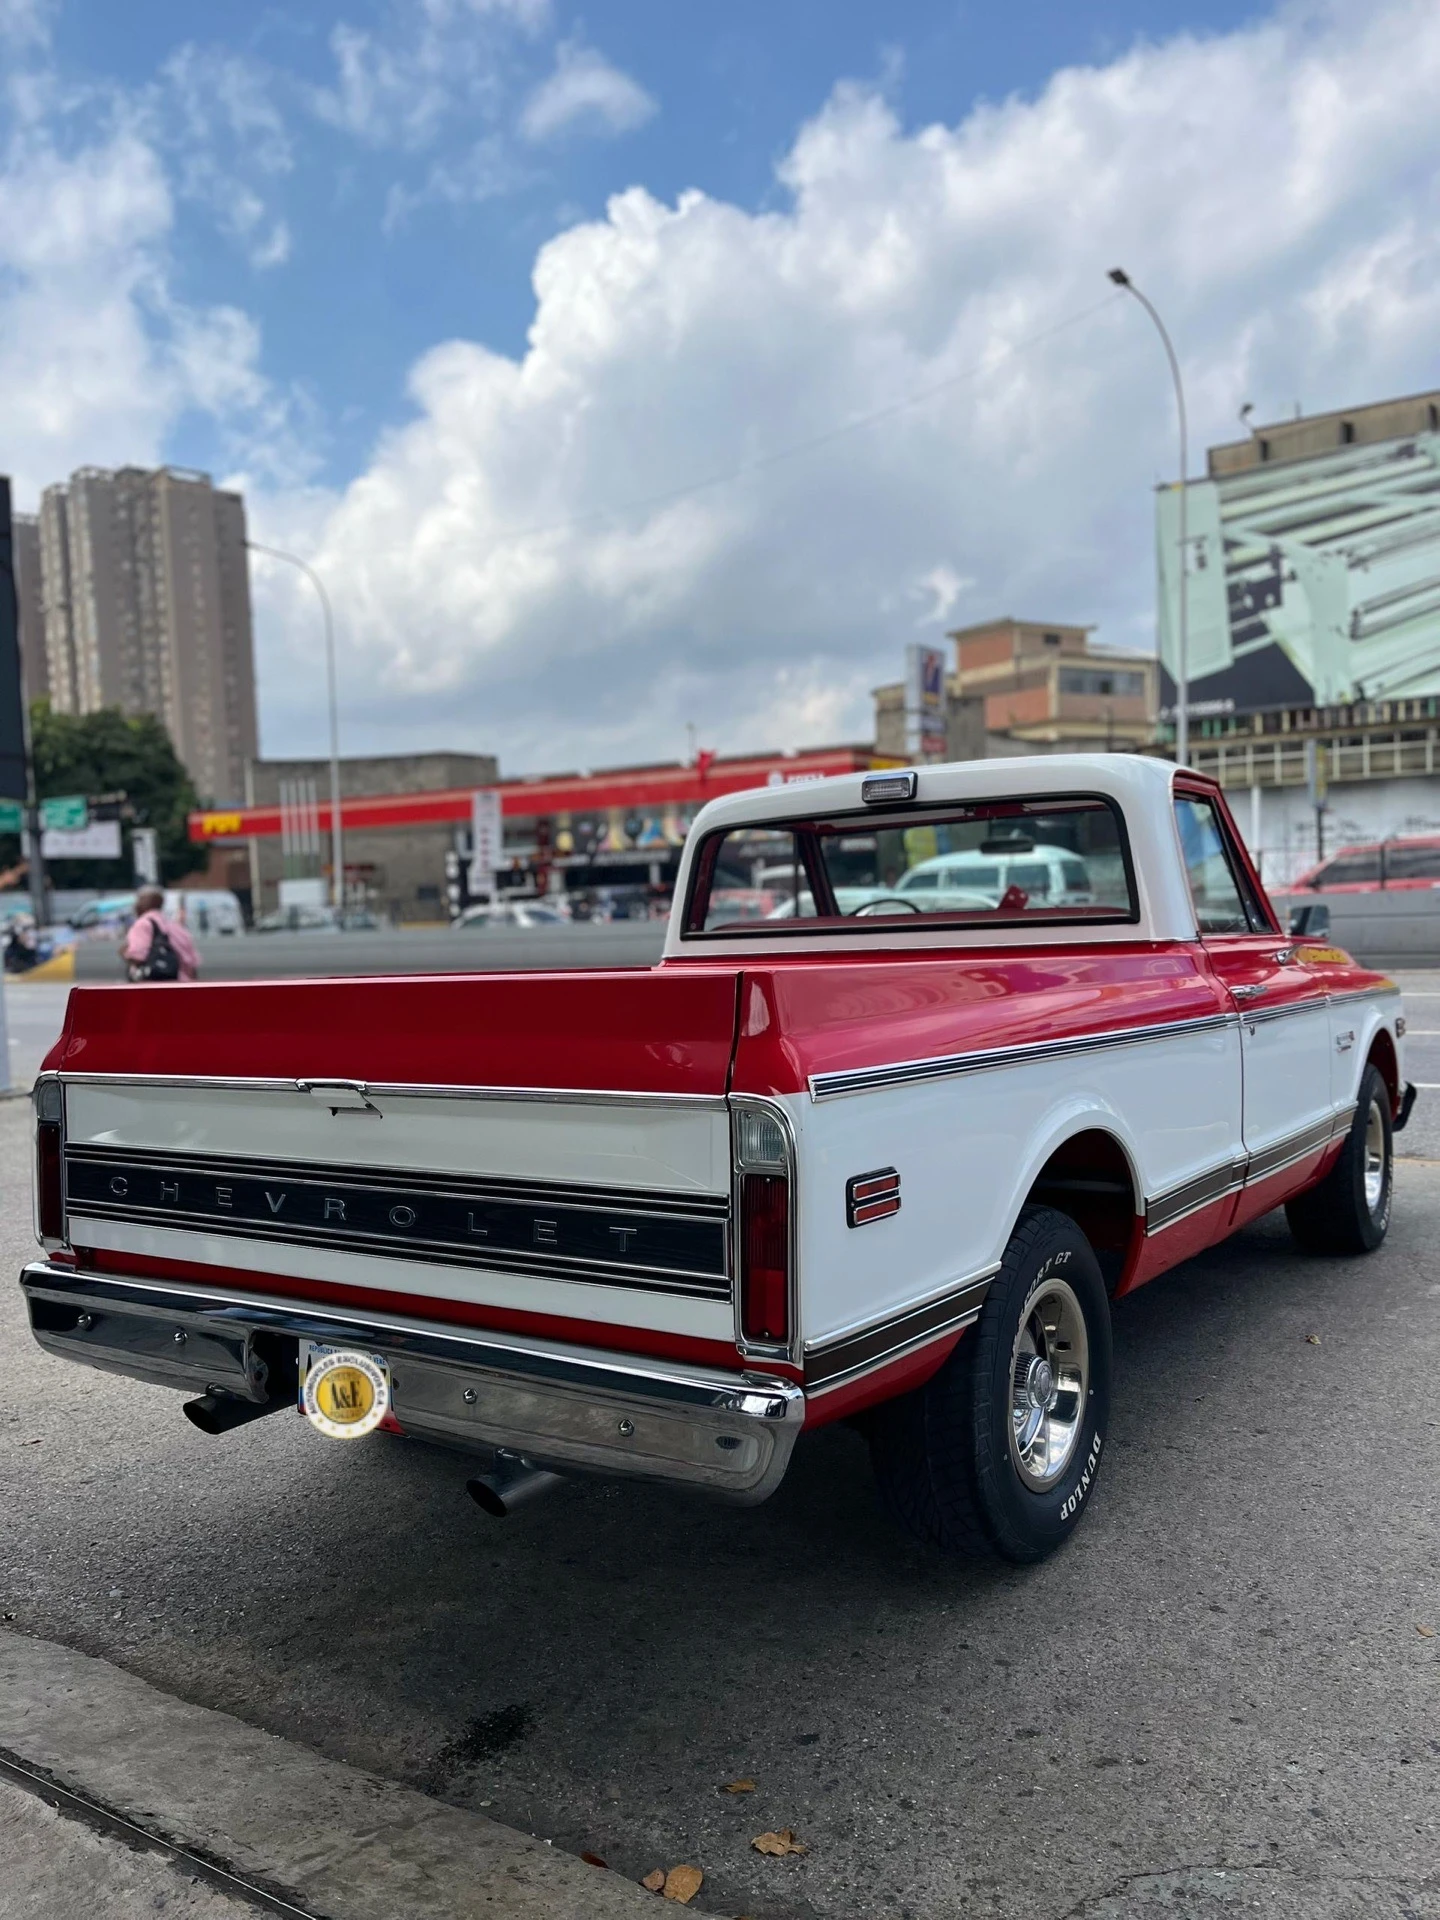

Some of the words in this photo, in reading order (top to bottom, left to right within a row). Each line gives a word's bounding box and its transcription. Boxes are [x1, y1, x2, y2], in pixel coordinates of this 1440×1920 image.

[109, 1176, 638, 1253] CHEVROLET
[1054, 1251, 1072, 1265] GT
[1060, 1431, 1101, 1521] DUNLOP
